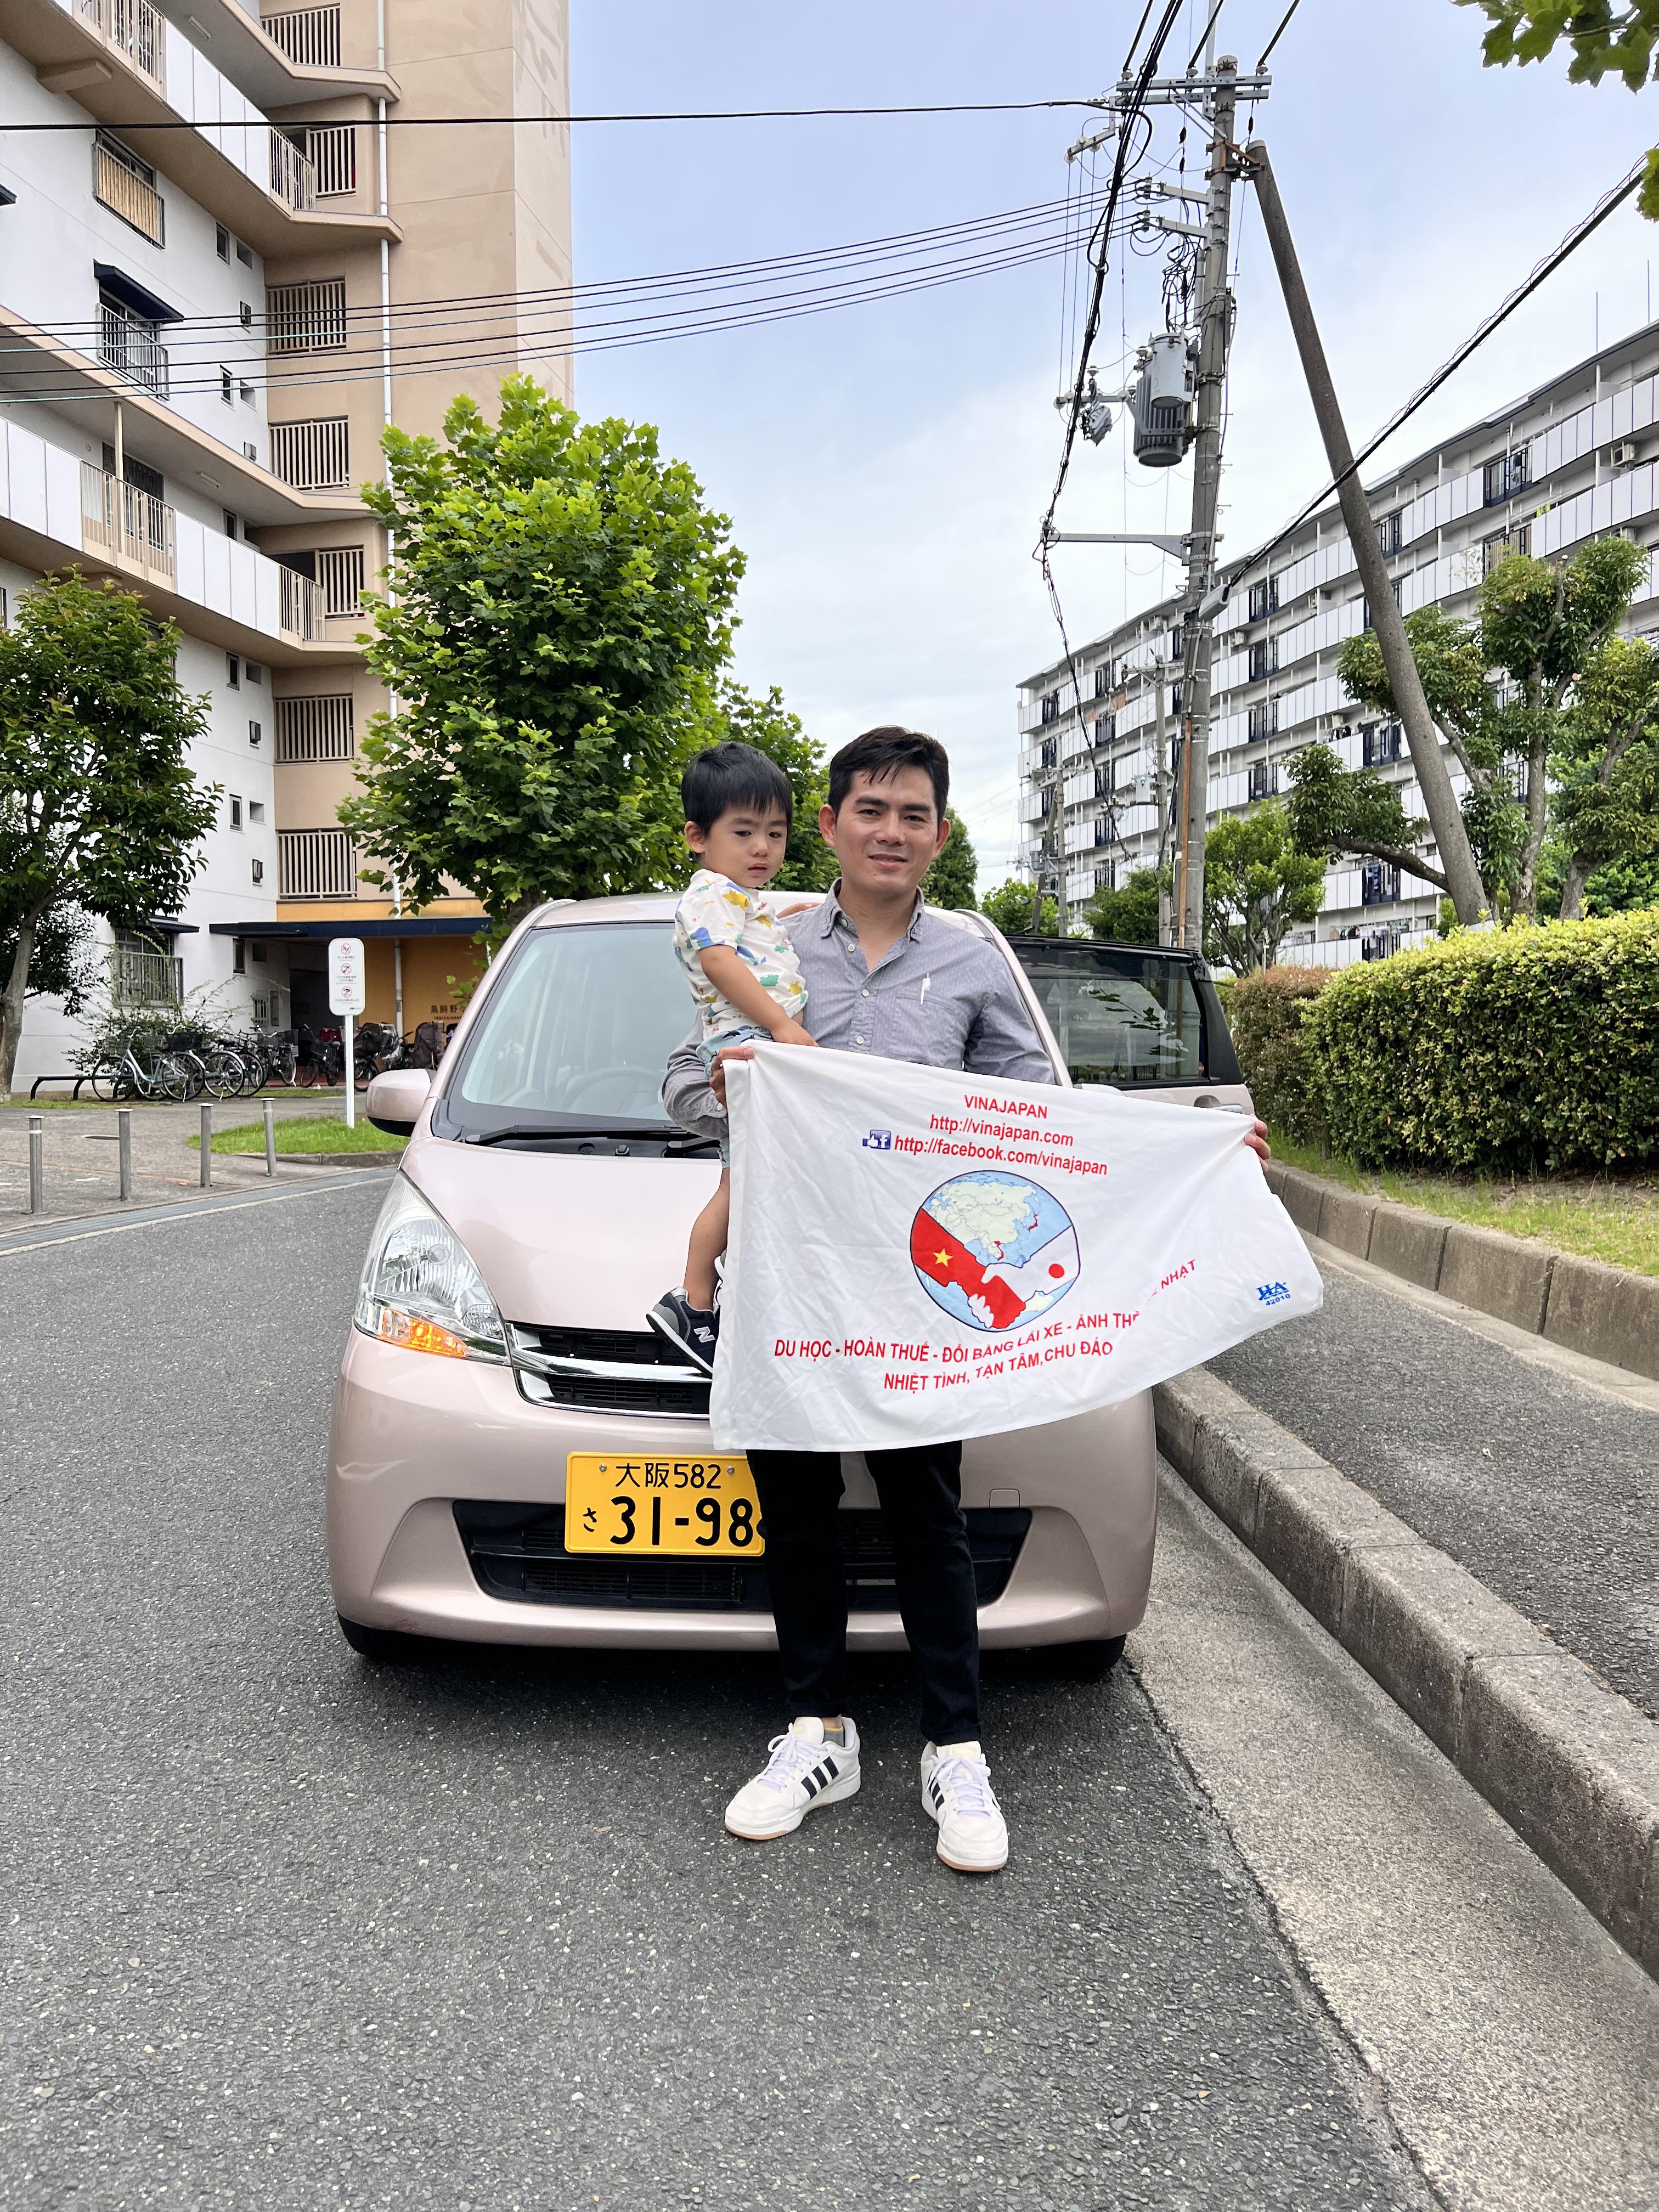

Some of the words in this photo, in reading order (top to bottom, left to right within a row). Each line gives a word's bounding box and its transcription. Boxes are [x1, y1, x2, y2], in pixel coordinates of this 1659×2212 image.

[963, 1094, 1048, 1120] VINAJAPAN
[929, 1114, 1074, 1147] http://vinajapan.com
[894, 1135, 1108, 1176] http://facebook.com/vinajapan
[1266, 1294, 1291, 1306] 42010
[774, 1339, 796, 1357] DU
[799, 1340, 832, 1362] HỌC
[844, 1336, 887, 1358] HOÀN
[890, 1341, 930, 1362] THUẾ
[1017, 1329, 1040, 1347] LÁI
[1043, 1322, 1063, 1340] XE
[884, 1372, 929, 1395] NHIỆT
[933, 1371, 970, 1390] TÌNH,
[615, 1462, 721, 1489] 大阪582
[582, 1507, 597, 1532] さ
[610, 1496, 754, 1547] 31-98
